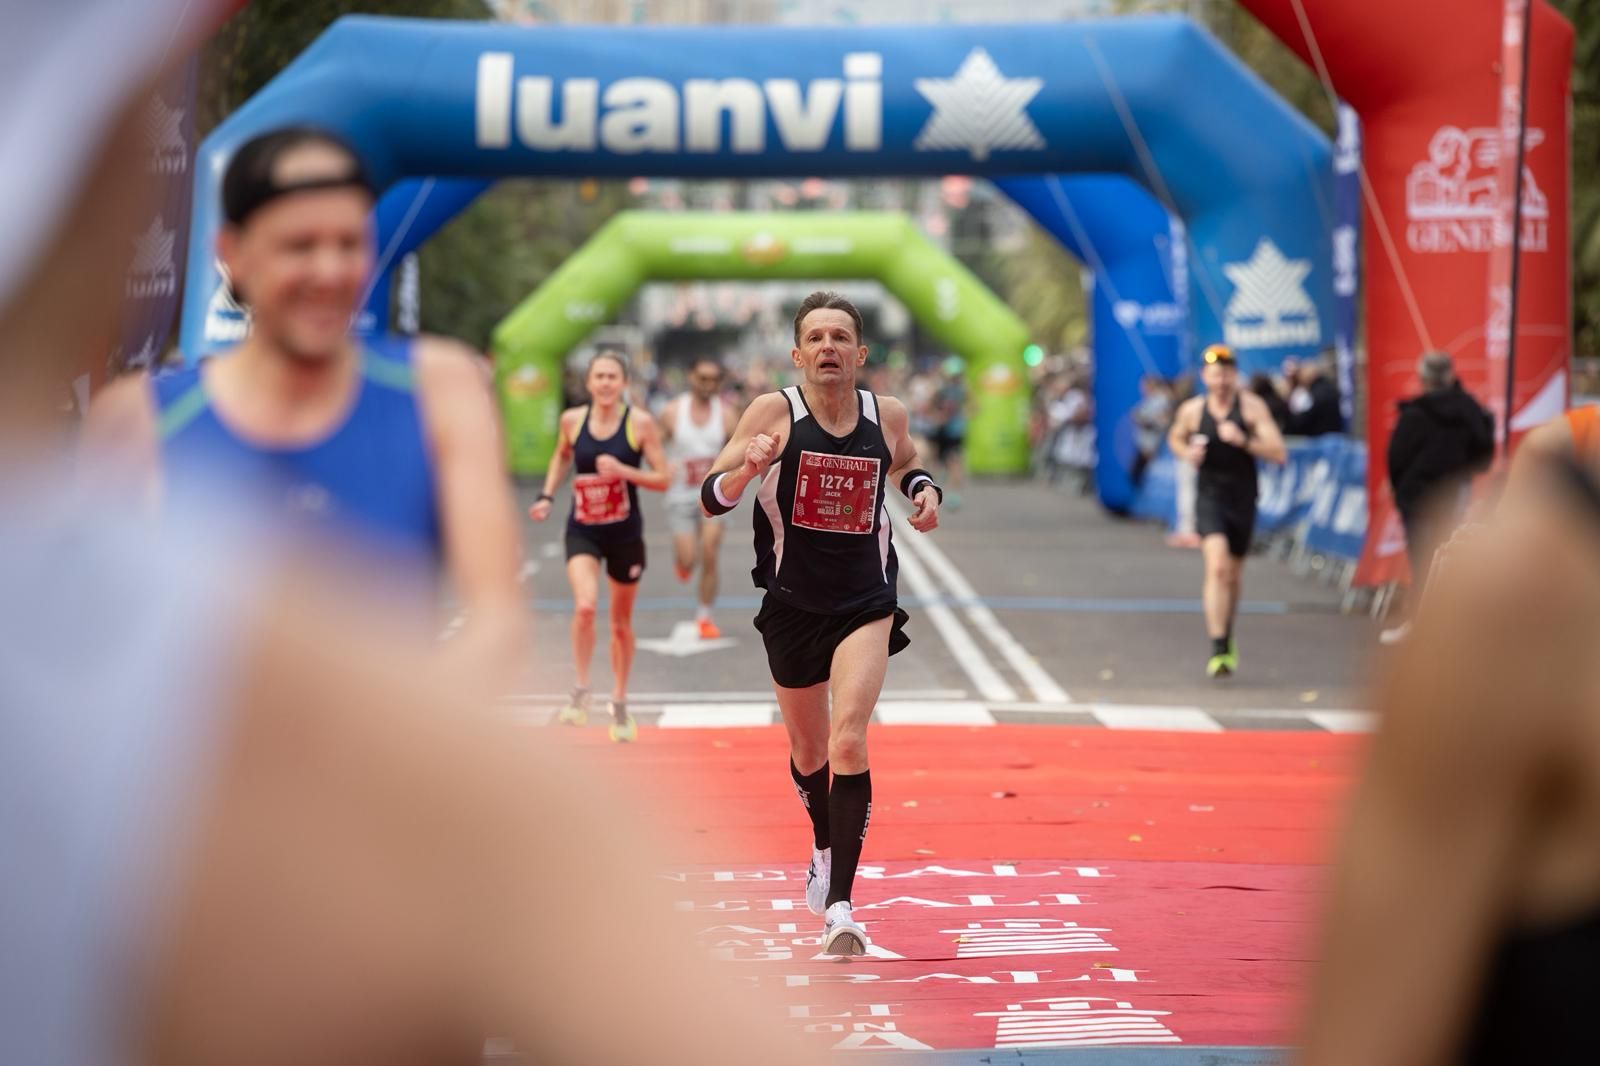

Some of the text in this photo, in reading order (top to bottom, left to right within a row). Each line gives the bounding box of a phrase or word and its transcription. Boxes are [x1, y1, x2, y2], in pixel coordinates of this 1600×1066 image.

[475, 52, 883, 153] luanvi
[1406, 220, 1548, 252] GENELI
[822, 458, 868, 471] GENERALI
[820, 474, 854, 491] 1274
